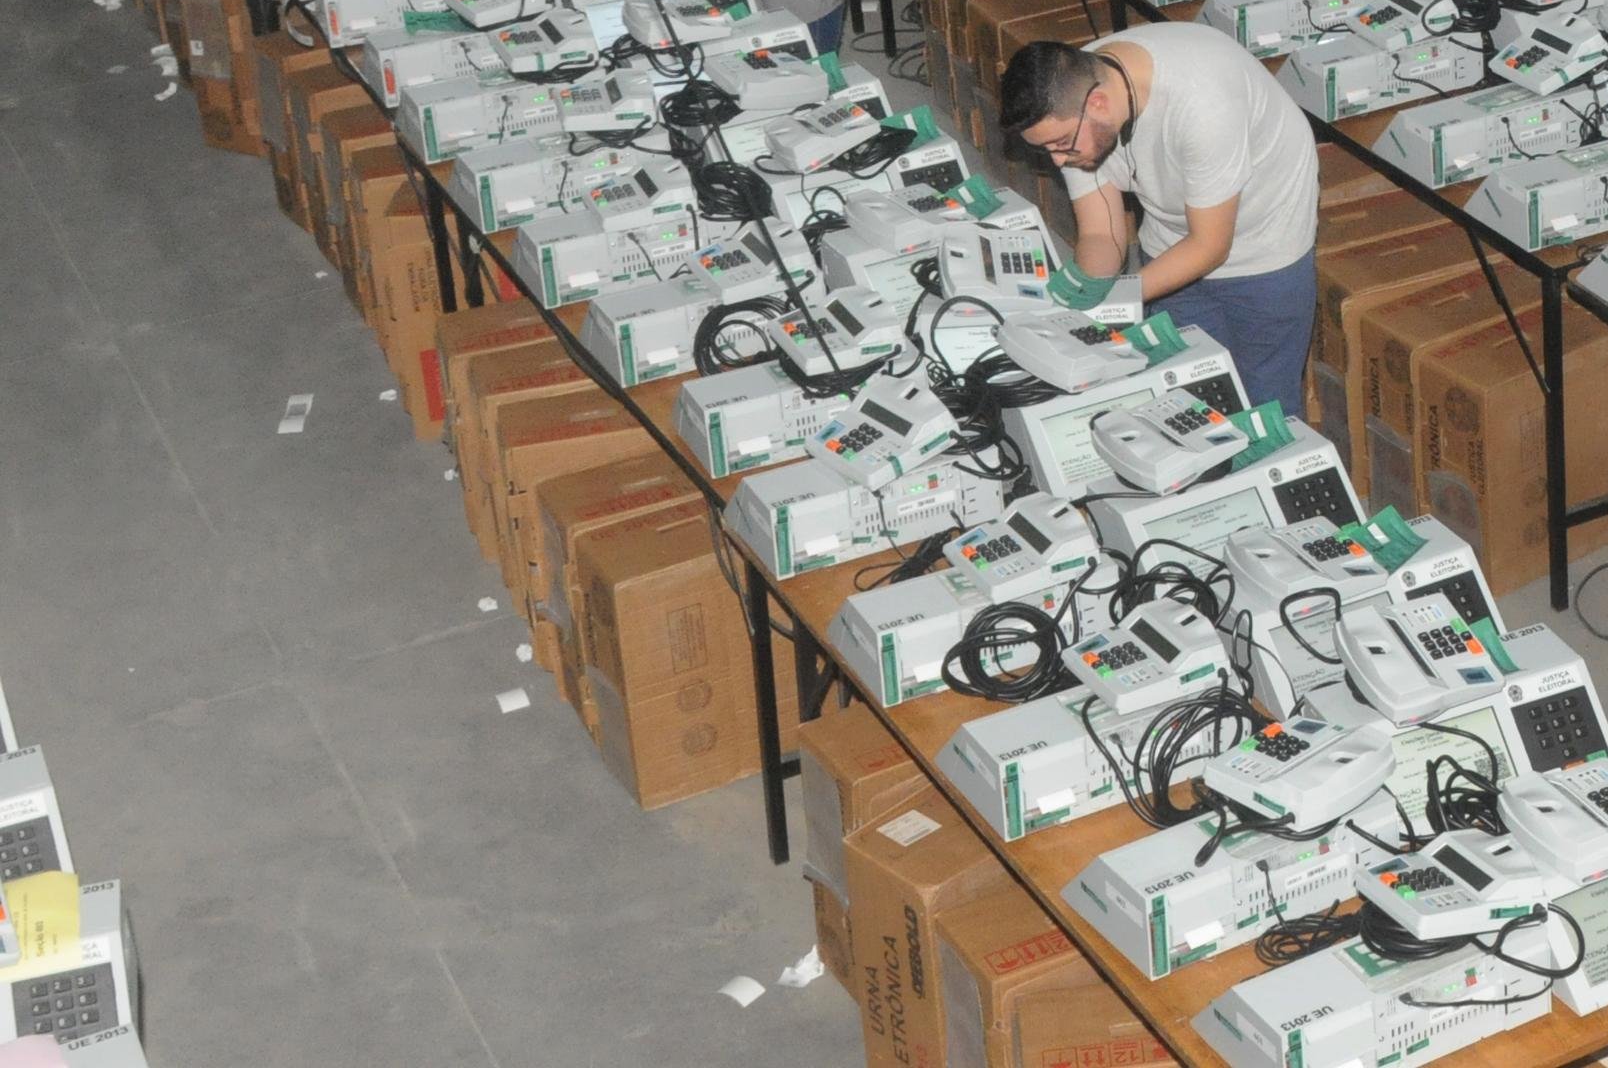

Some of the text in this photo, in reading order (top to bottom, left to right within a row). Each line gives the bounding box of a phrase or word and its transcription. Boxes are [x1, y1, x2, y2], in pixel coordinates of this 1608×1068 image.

[1189, 364, 1222, 379] ELEITORAL
[1192, 359, 1218, 371] JUSTIÇA
[1295, 460, 1328, 475] ELEITORAL
[1297, 453, 1323, 466] JUSTIÇA
[771, 496, 798, 508] 2013
[1431, 555, 1460, 570] JUSTIÇA
[1429, 563, 1465, 579] ELEITORAL
[877, 612, 925, 631] UE 2013
[1500, 624, 1545, 643] UE 2013
[1541, 669, 1571, 685] JUSTIÇA
[1538, 678, 1578, 694] ELEITORAL
[7, 746, 37, 761] 2013
[999, 740, 1048, 761] UE 2013
[82, 881, 115, 896] 2013
[1144, 870, 1196, 895] UE 2013
[864, 965, 886, 1036] URNA
[1280, 1005, 1334, 1033] UE 2013
[67, 1026, 130, 1051] UE 2013
